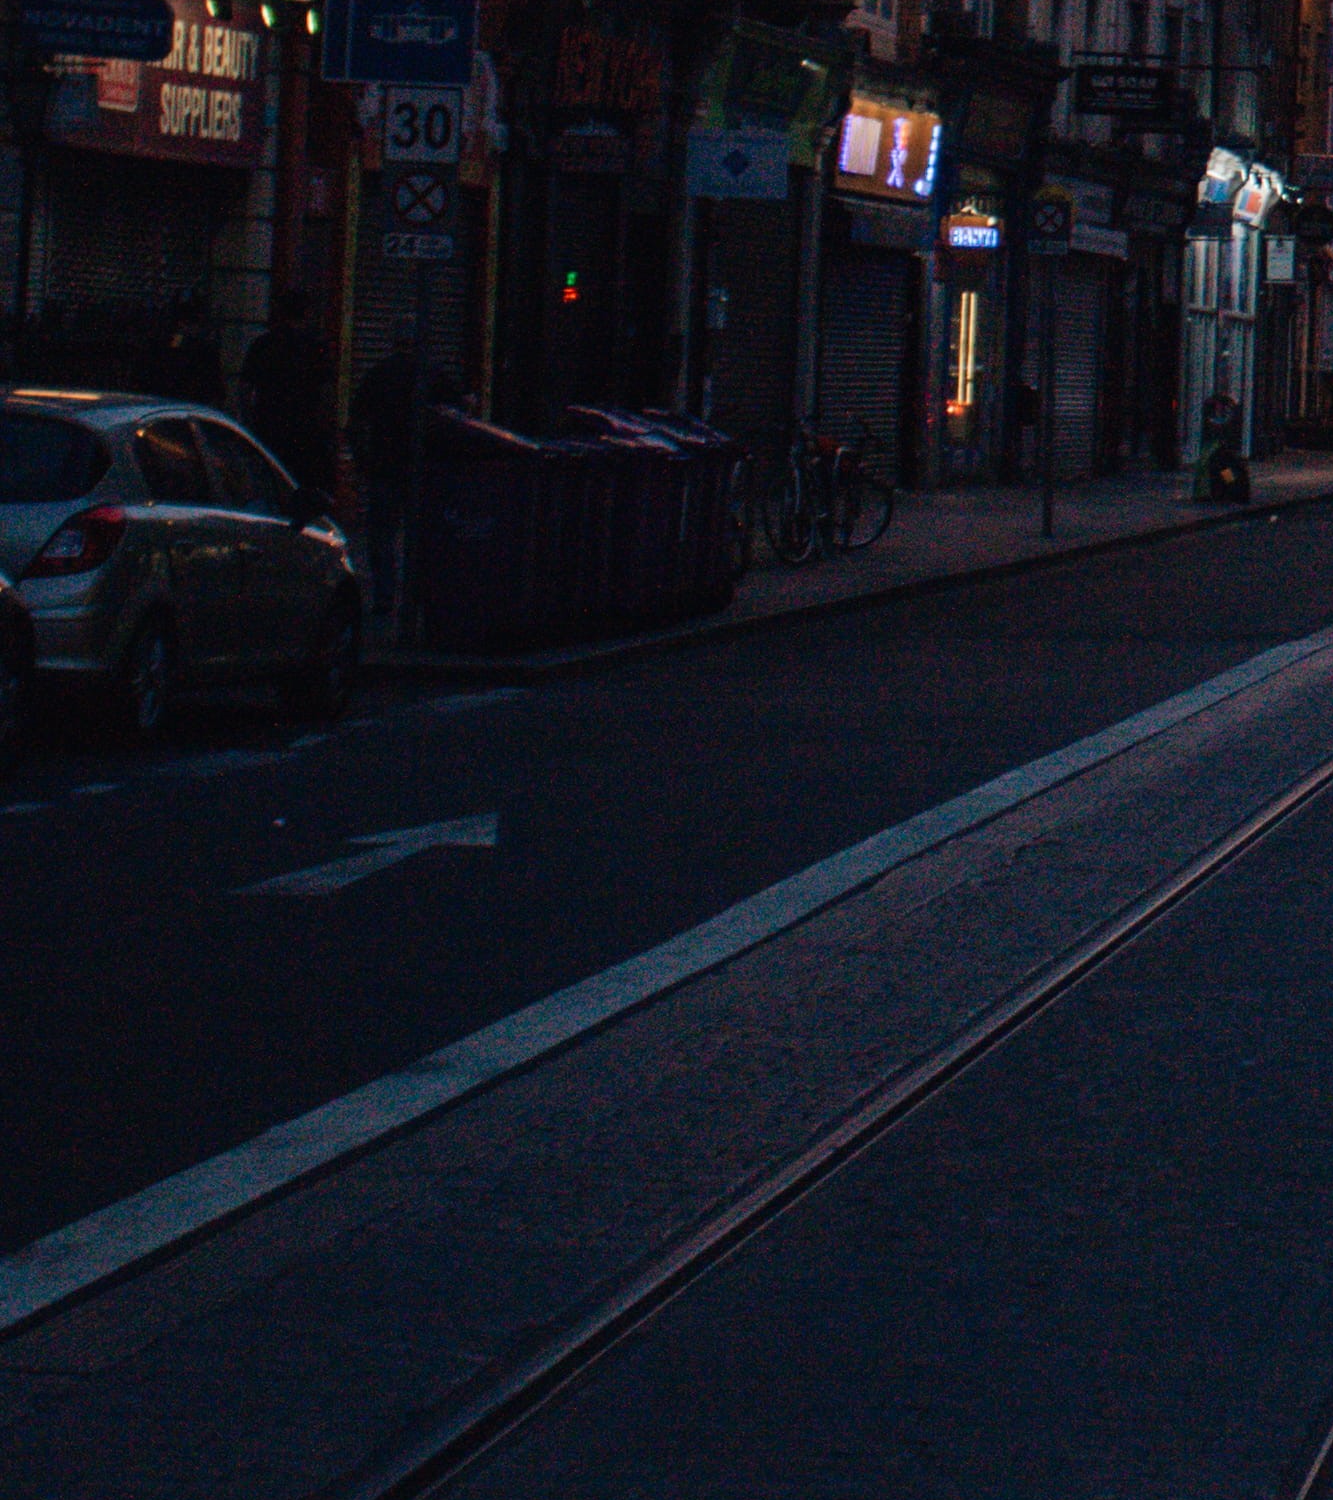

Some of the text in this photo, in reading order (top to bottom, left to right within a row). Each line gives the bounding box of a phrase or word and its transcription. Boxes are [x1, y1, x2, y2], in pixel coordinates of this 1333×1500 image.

[202, 25, 259, 82] BEAUTY
[159, 83, 242, 143] SUPPLIERS
[392, 103, 451, 149] 30
